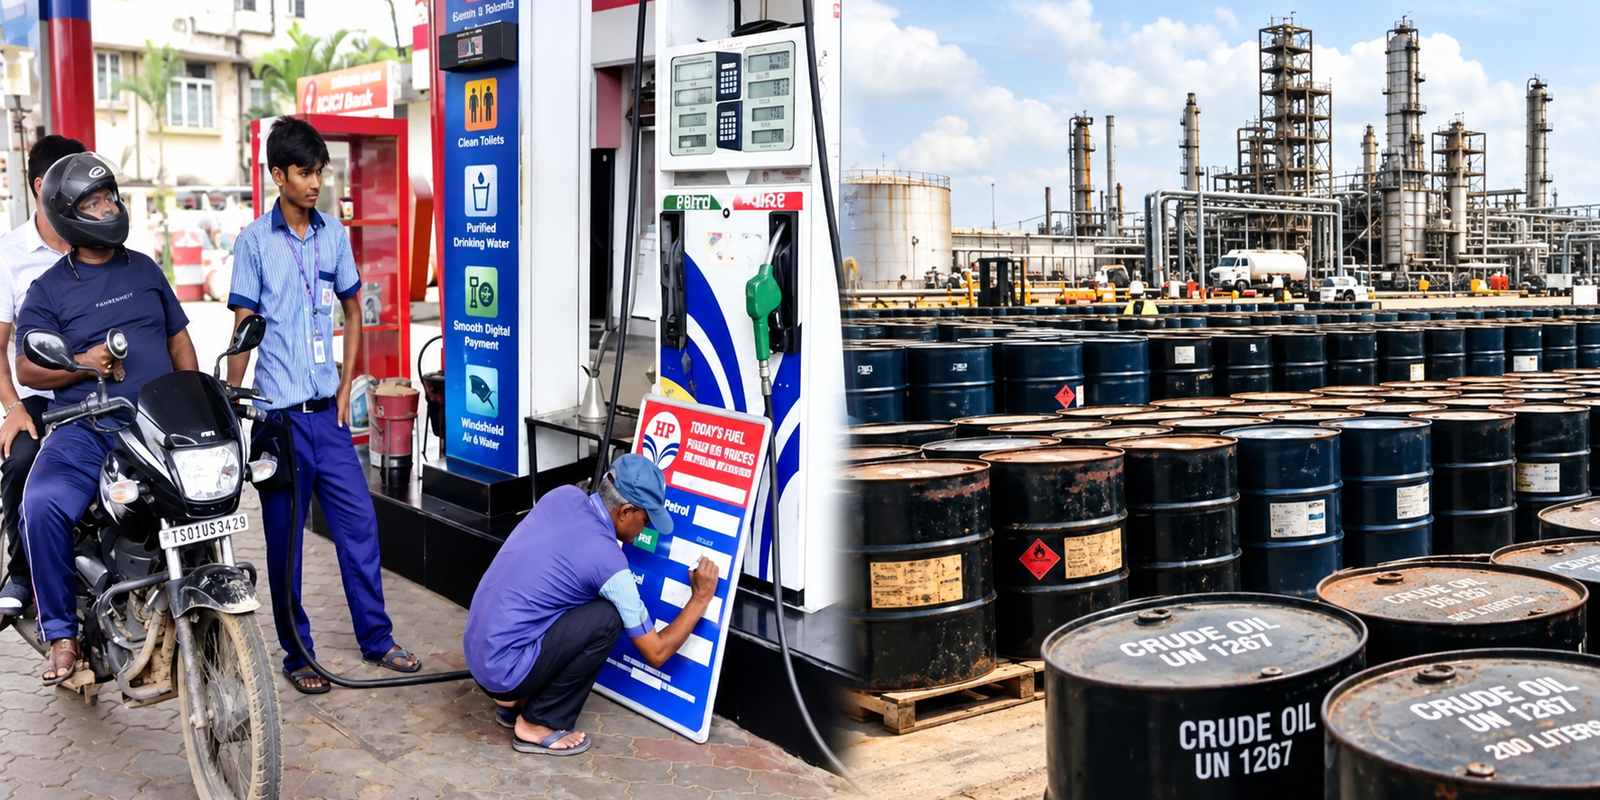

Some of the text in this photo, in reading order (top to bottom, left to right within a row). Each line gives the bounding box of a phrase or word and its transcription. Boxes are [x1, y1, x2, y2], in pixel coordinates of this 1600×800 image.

[344, 88, 373, 109] Bank
[458, 135, 505, 148] Clean Toilets
[466, 223, 497, 234] Purified
[453, 237, 510, 250] Drinking Water
[453, 320, 511, 337] Smooth Digital
[464, 337, 499, 350] Payment
[460, 416, 504, 436] Windshield
[654, 420, 675, 439] HP
[690, 421, 746, 445] TODAY'S FUEL
[462, 432, 472, 443] Air
[479, 435, 500, 450] Water
[664, 498, 690, 517] Petrol
[171, 516, 246, 543] TS01US3429
[1383, 584, 1452, 604] CRUDE
[1119, 617, 1281, 657] CRUDE OIL
[1159, 632, 1273, 667] UN 1267
[1409, 676, 1580, 721] CRUDE OIL
[1458, 695, 1577, 733] UN 1267
[1179, 702, 1316, 750] CRUDE OIL
[1484, 720, 1600, 760] 200 LITERS
[1195, 739, 1293, 780] UN 1267
